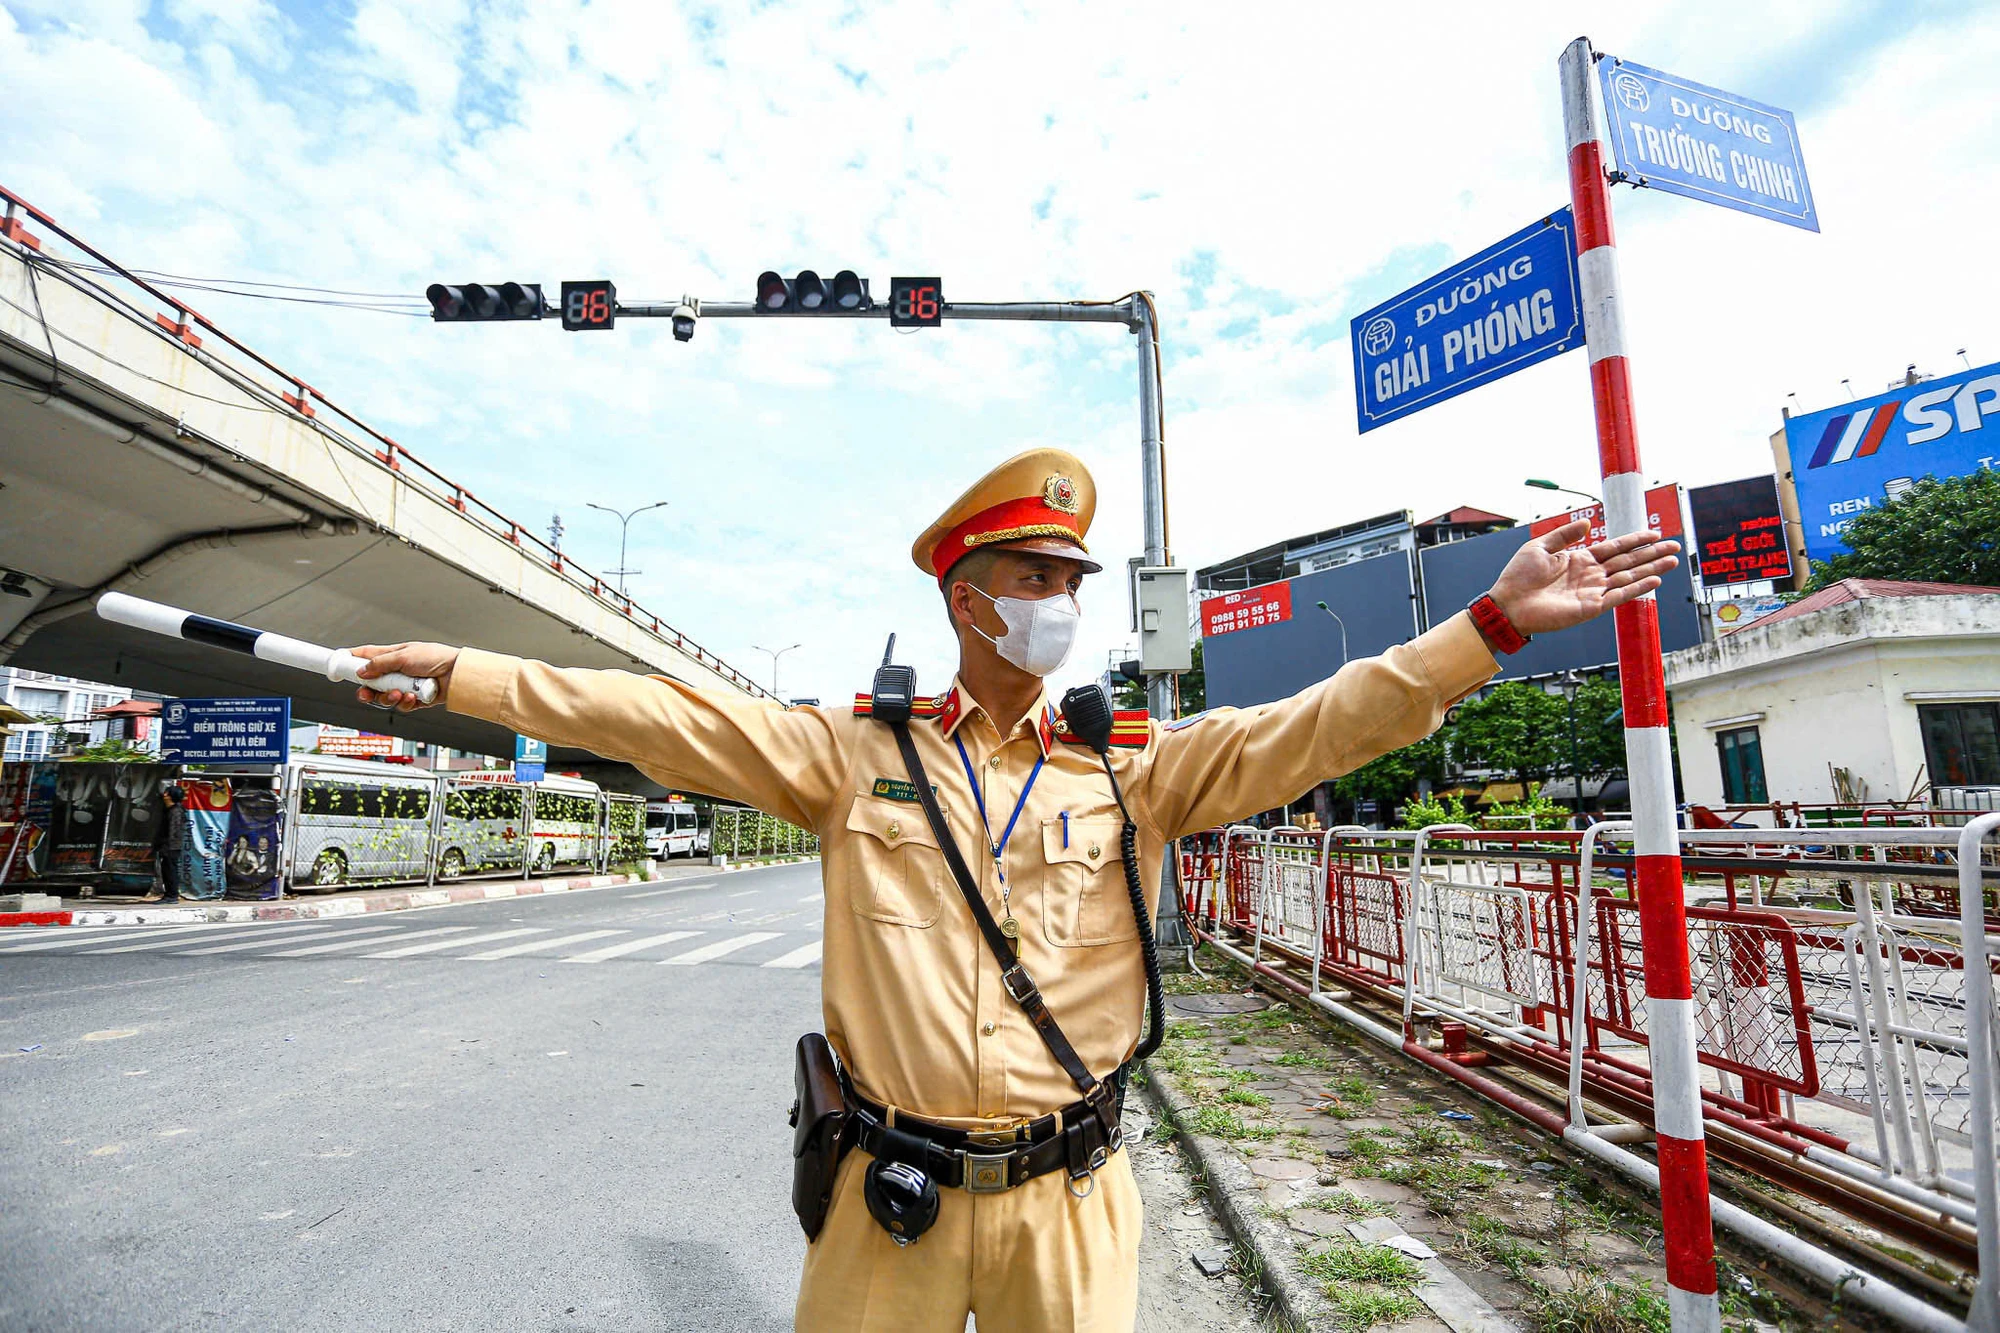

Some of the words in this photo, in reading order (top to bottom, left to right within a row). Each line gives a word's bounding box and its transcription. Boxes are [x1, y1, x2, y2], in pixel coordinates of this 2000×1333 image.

[1670, 96, 1773, 145] ĐƯỜNG
[1629, 121, 1727, 184] TRƯỜNG
[1729, 150, 1799, 204] CHINH
[1414, 254, 1533, 328] ĐƯỜNG
[1374, 335, 1431, 403] GIẢI
[1442, 288, 1556, 374] PHÓNG
[1829, 496, 1872, 517] REN
[1737, 551, 1788, 571] TRANG
[1225, 593, 1240, 605] RED
[1211, 612, 1235, 625] 0988
[1236, 608, 1249, 619] 59
[1251, 605, 1264, 616] 55
[1266, 601, 1279, 612] 66
[1211, 622, 1235, 635] 0978
[1237, 618, 1249, 629] 91
[1252, 615, 1265, 626] 70
[1267, 612, 1280, 623] 75
[193, 718, 215, 733] ĐIỂM
[217, 720, 246, 733] TRÔNG
[248, 720, 263, 733] GIỮ
[265, 722, 276, 733] XE
[212, 734, 234, 747] NGÀY
[236, 734, 246, 747] VÀ
[248, 735, 267, 747] ĐÊM
